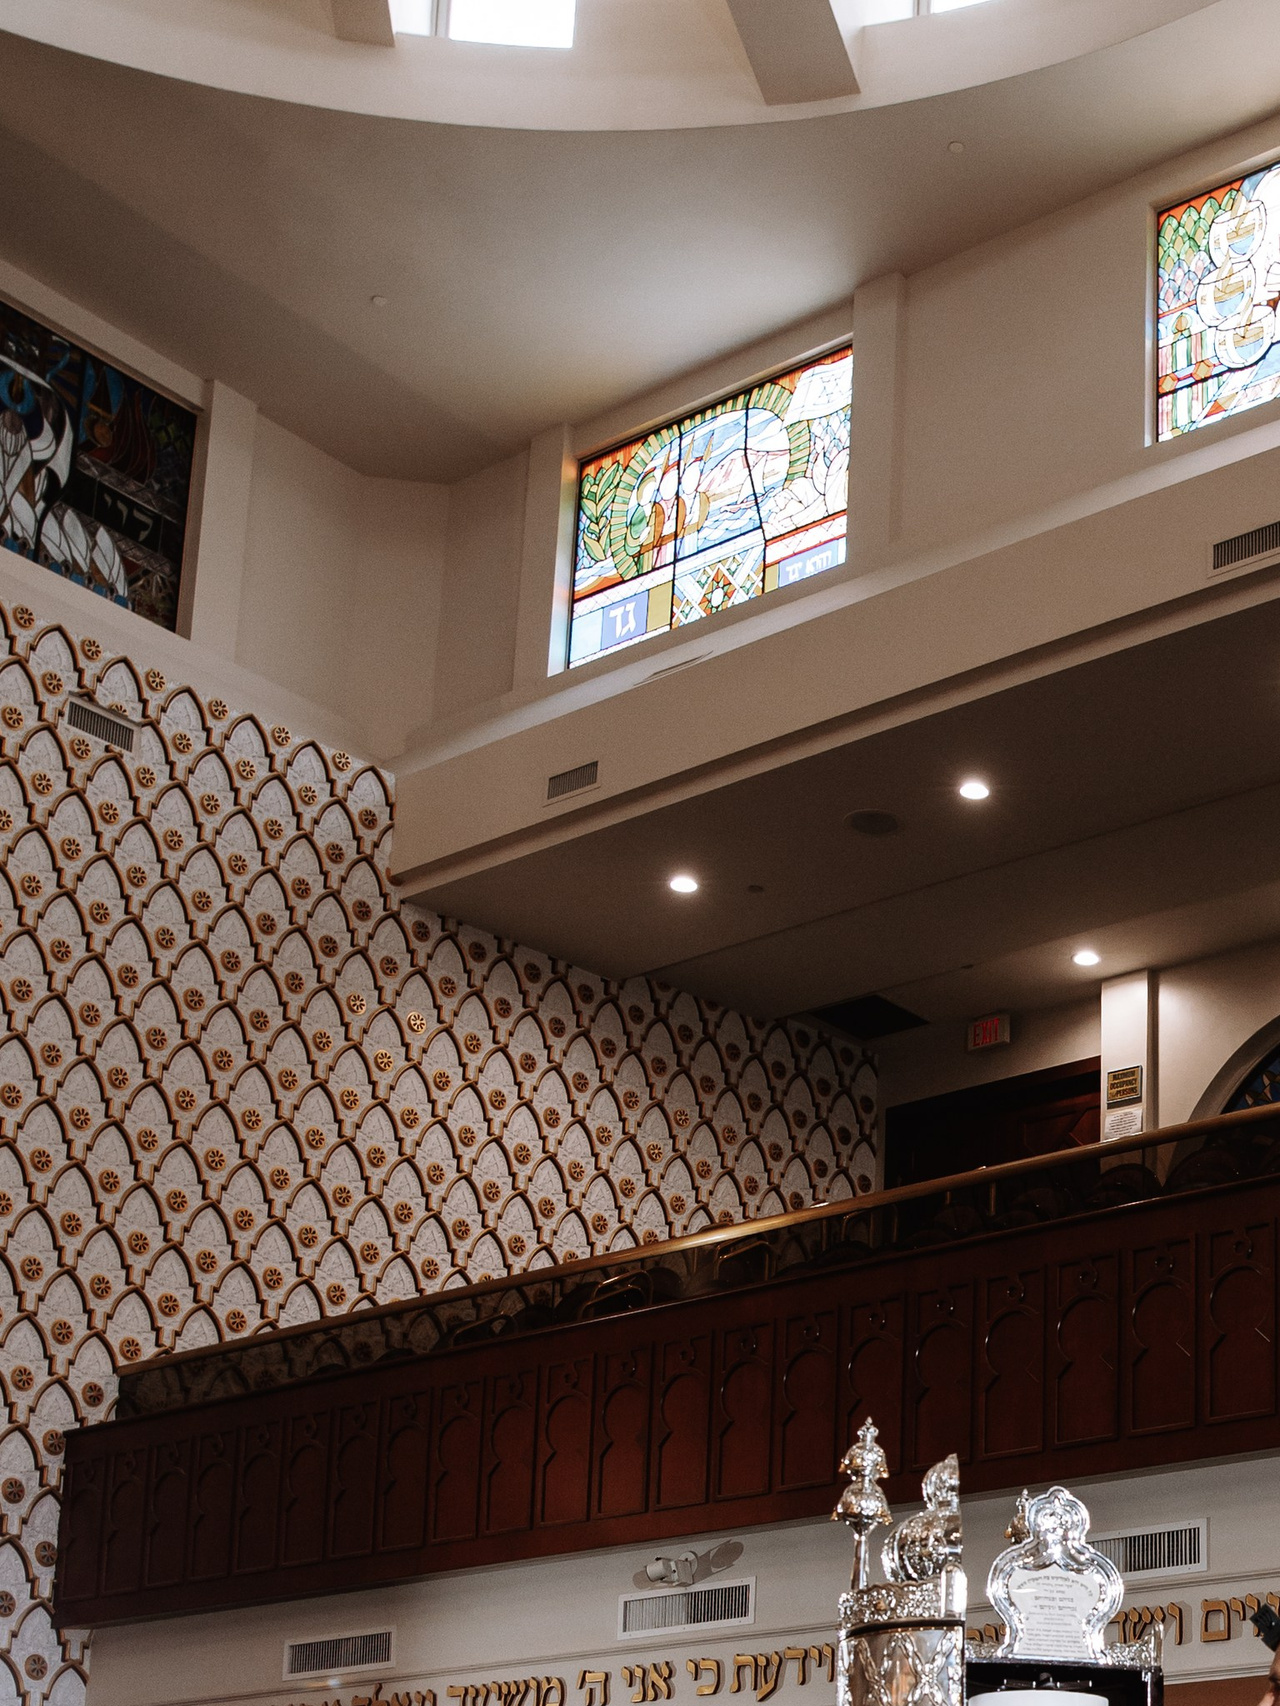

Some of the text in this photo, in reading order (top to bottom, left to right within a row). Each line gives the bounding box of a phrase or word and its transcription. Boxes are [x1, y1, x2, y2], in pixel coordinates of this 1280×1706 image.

[104, 493, 154, 541] לוי
[609, 601, 637, 639] גד
[973, 1018, 1000, 1047] EXIT
[621, 1660, 675, 1703] אני
[686, 1657, 721, 1696] כי
[730, 1643, 835, 1702] וידעת
